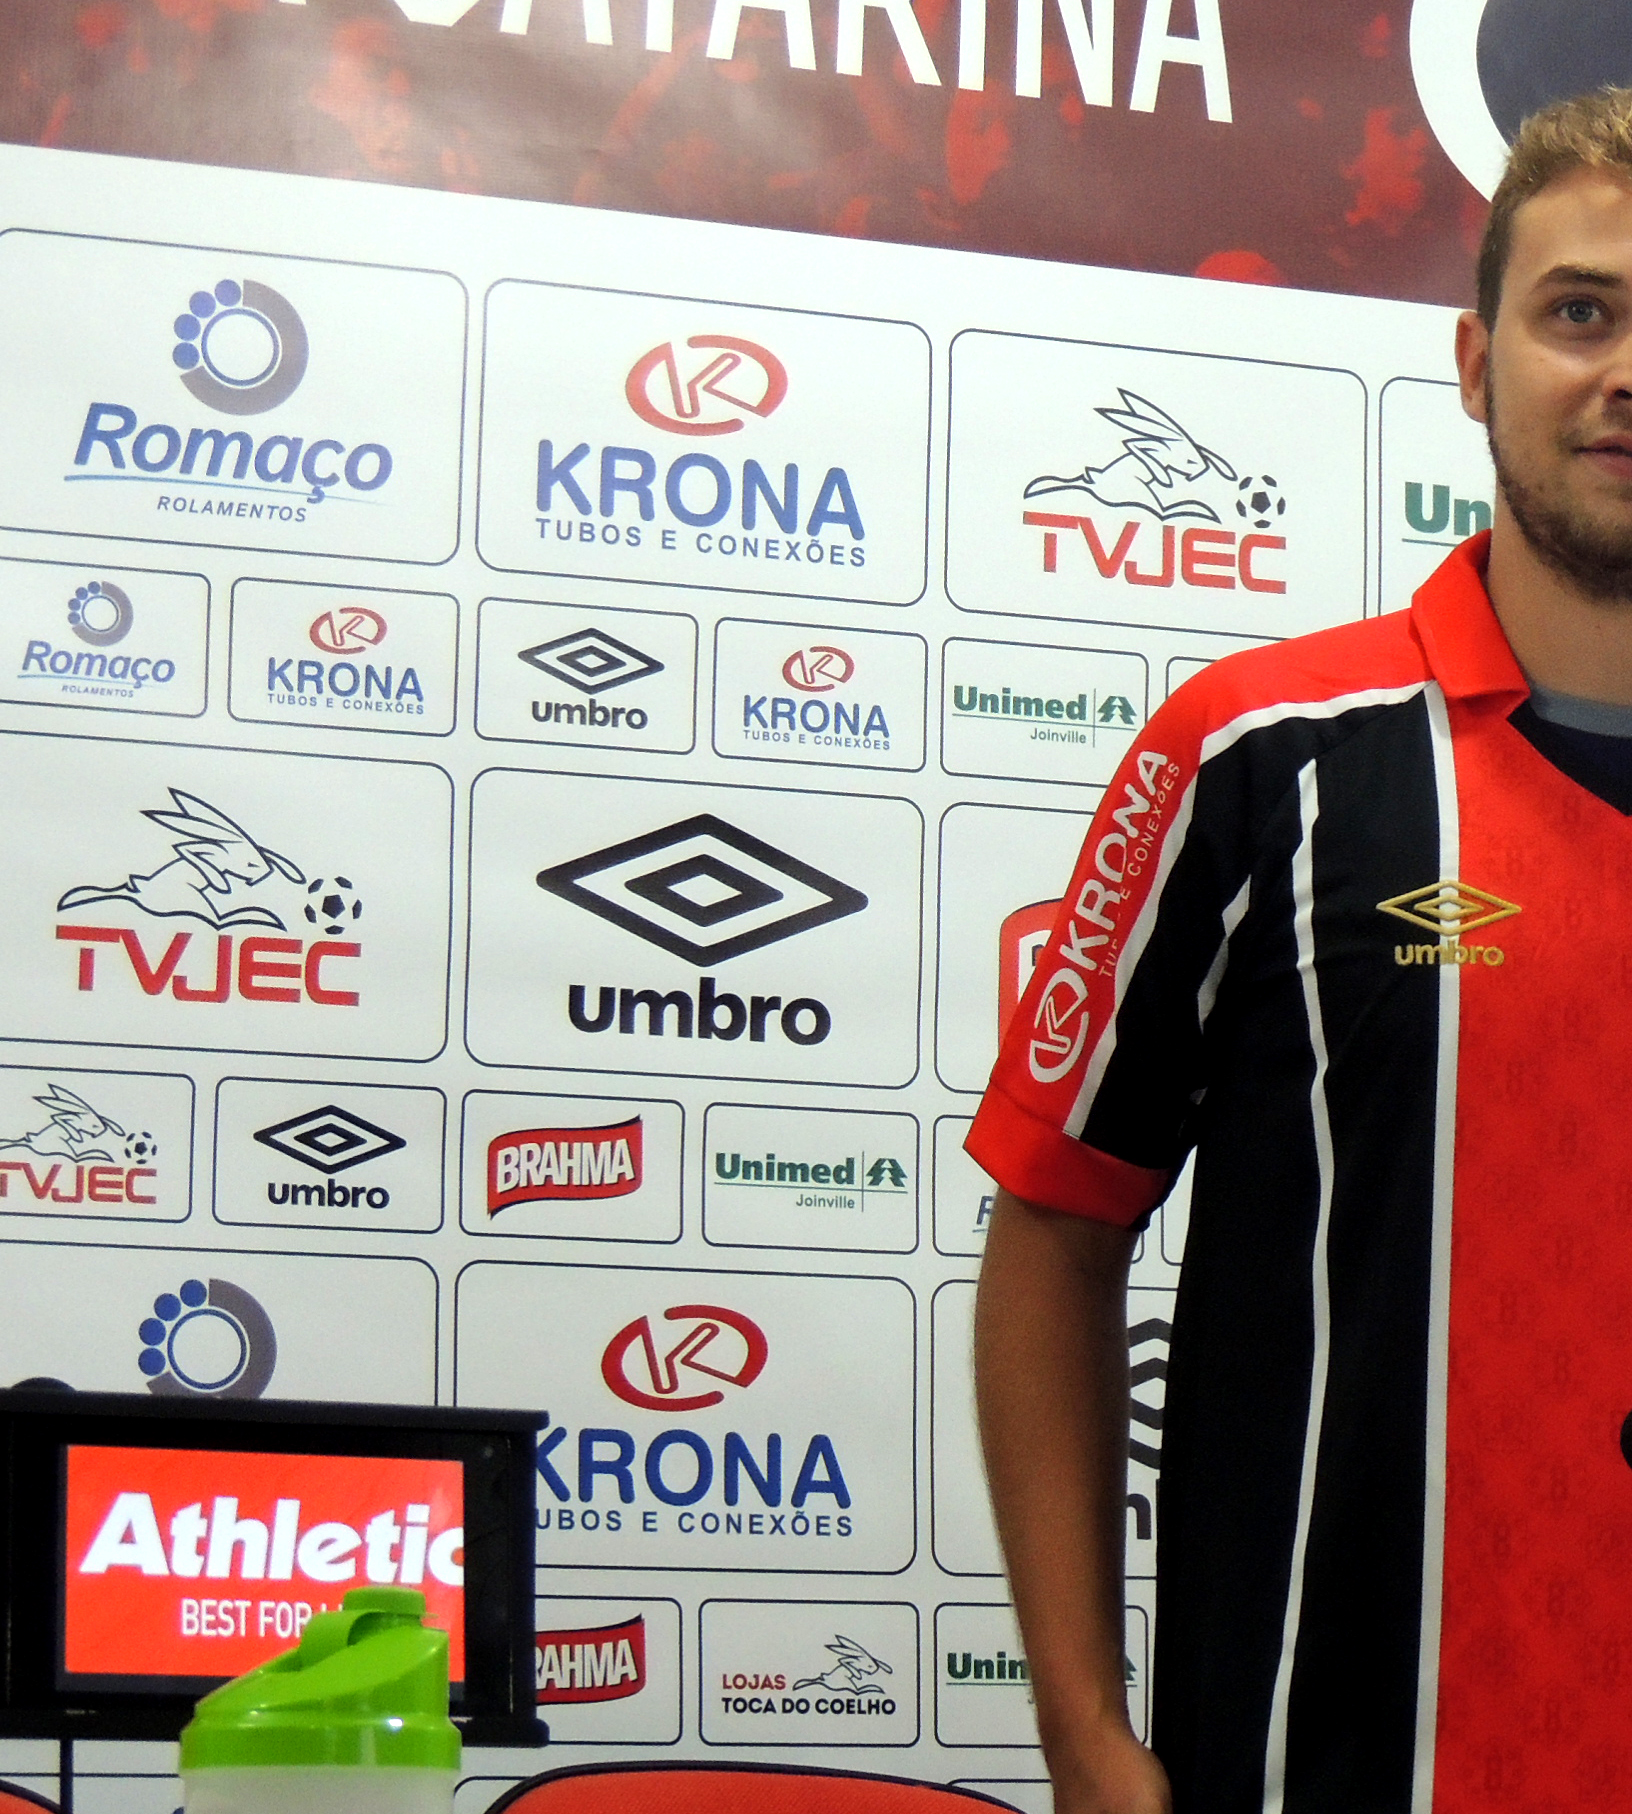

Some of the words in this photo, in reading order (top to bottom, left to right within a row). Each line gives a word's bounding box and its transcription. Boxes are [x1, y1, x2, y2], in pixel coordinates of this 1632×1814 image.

[74, 403, 392, 503] Romaço
[536, 439, 865, 541] KRONA
[157, 496, 307, 522] ROLAMENTOS
[536, 519, 641, 548] TUBOS
[661, 529, 677, 551] E
[696, 531, 866, 568] CONEXÕES
[23, 640, 175, 689] Romaço
[268, 657, 424, 702] KRONA
[61, 685, 134, 699] ROLAMENTOS
[268, 693, 317, 707] TUBOS
[326, 698, 334, 708] E
[342, 697, 424, 715] CONEXÕES
[953, 685, 1087, 721] Unimed
[532, 700, 648, 730] umbro
[743, 695, 890, 739] KRONA
[743, 730, 790, 743] TUBOS
[798, 734, 806, 744] E
[814, 734, 891, 751] CONEXÕES
[1030, 728, 1087, 744] Joinville
[1060, 750, 1168, 971] KRONA
[1394, 939, 1504, 966] umbro
[569, 976, 831, 1045] umbro
[496, 1138, 634, 1190] BRAHMA
[715, 1152, 855, 1185] Unimed
[268, 1179, 389, 1209] umbro
[796, 1194, 855, 1209] Joinville
[536, 1508, 621, 1533] UBOS
[642, 1512, 658, 1533] E
[677, 1511, 853, 1537] CONEXÕES
[181, 1598, 251, 1636] BEST
[722, 1674, 787, 1690] LOJAS
[721, 1698, 777, 1715] TOCA
[781, 1698, 811, 1715] DO
[816, 1698, 896, 1716] COELHO
